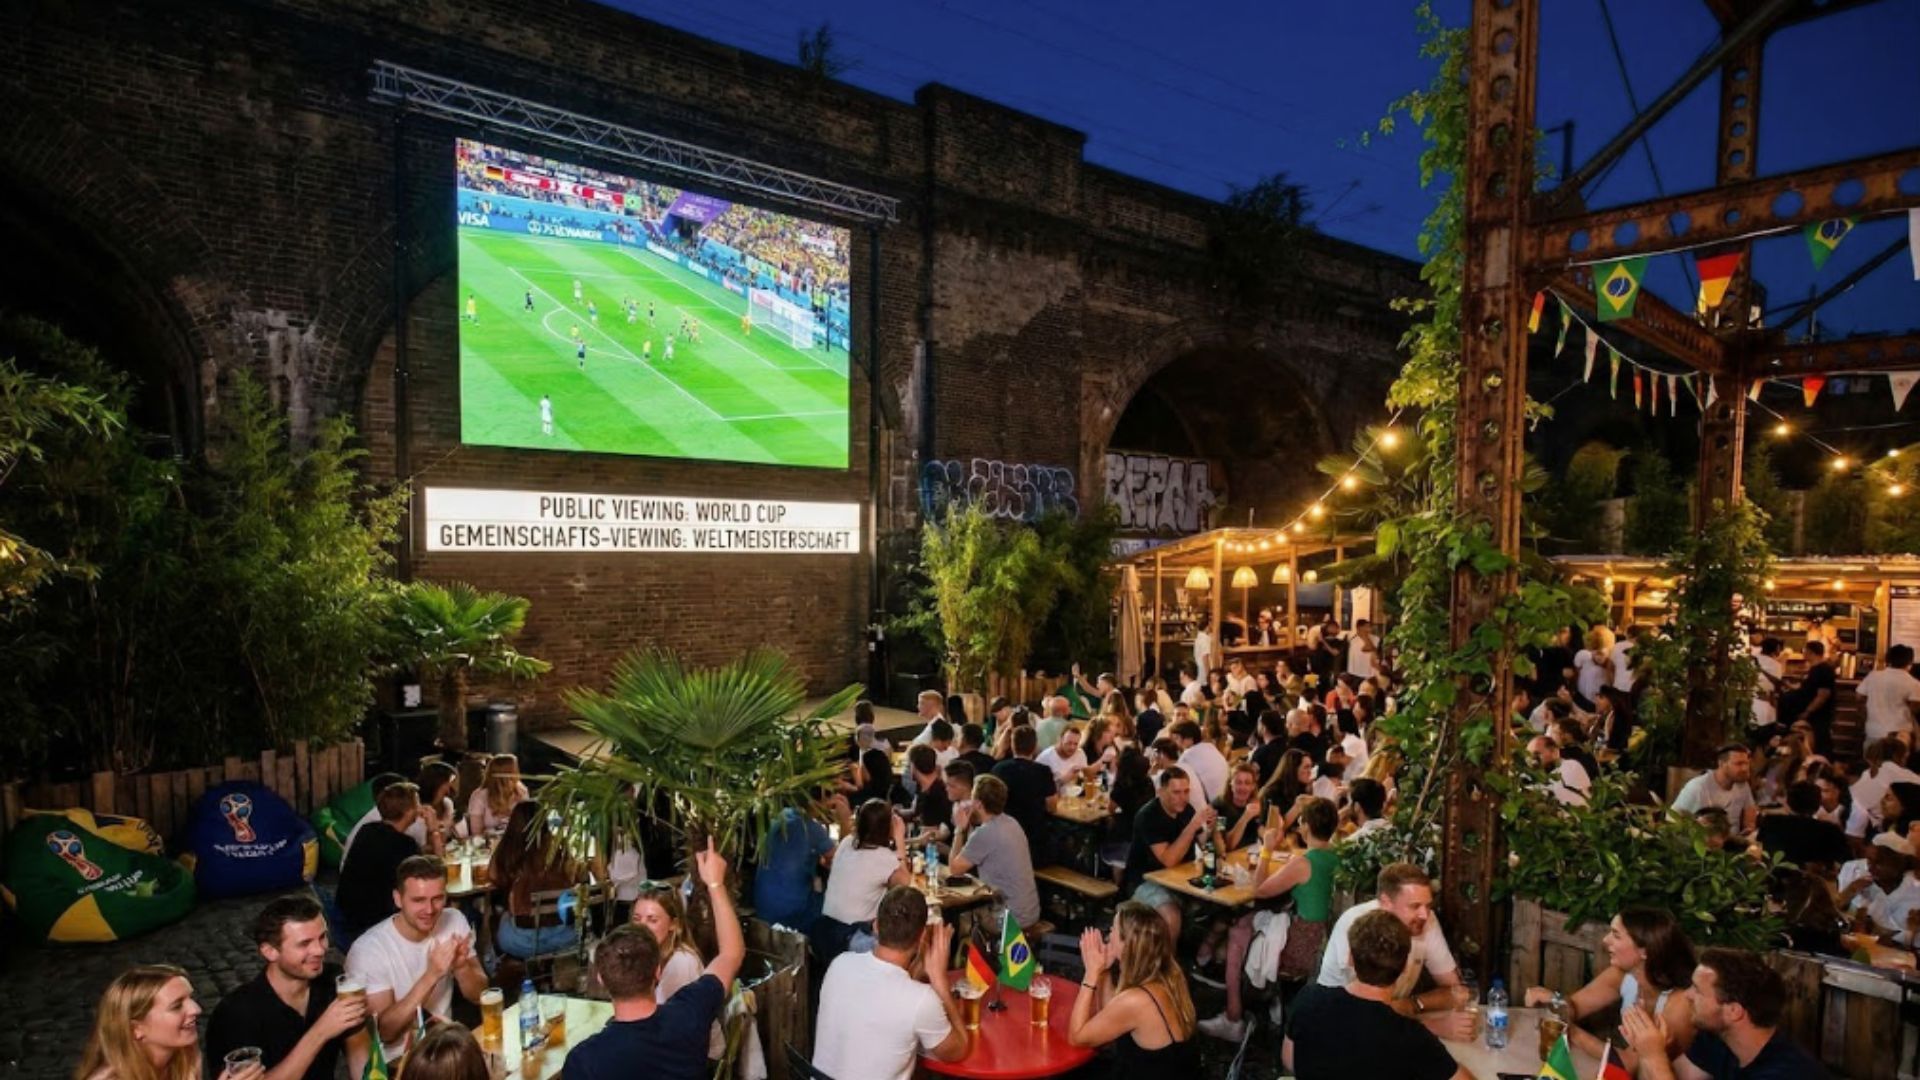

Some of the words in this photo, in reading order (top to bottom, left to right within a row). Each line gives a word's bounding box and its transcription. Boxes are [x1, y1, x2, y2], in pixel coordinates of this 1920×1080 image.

[458, 210, 490, 227] VISA
[539, 496, 606, 519] PUBLIC
[611, 499, 690, 521] VIEWING:
[695, 501, 750, 522] WORLD
[756, 504, 786, 523] CUP
[439, 524, 688, 548] GEMEINSCHAFTS-VIEWING:
[692, 529, 850, 550] WELTMEISTERSCHAFT
